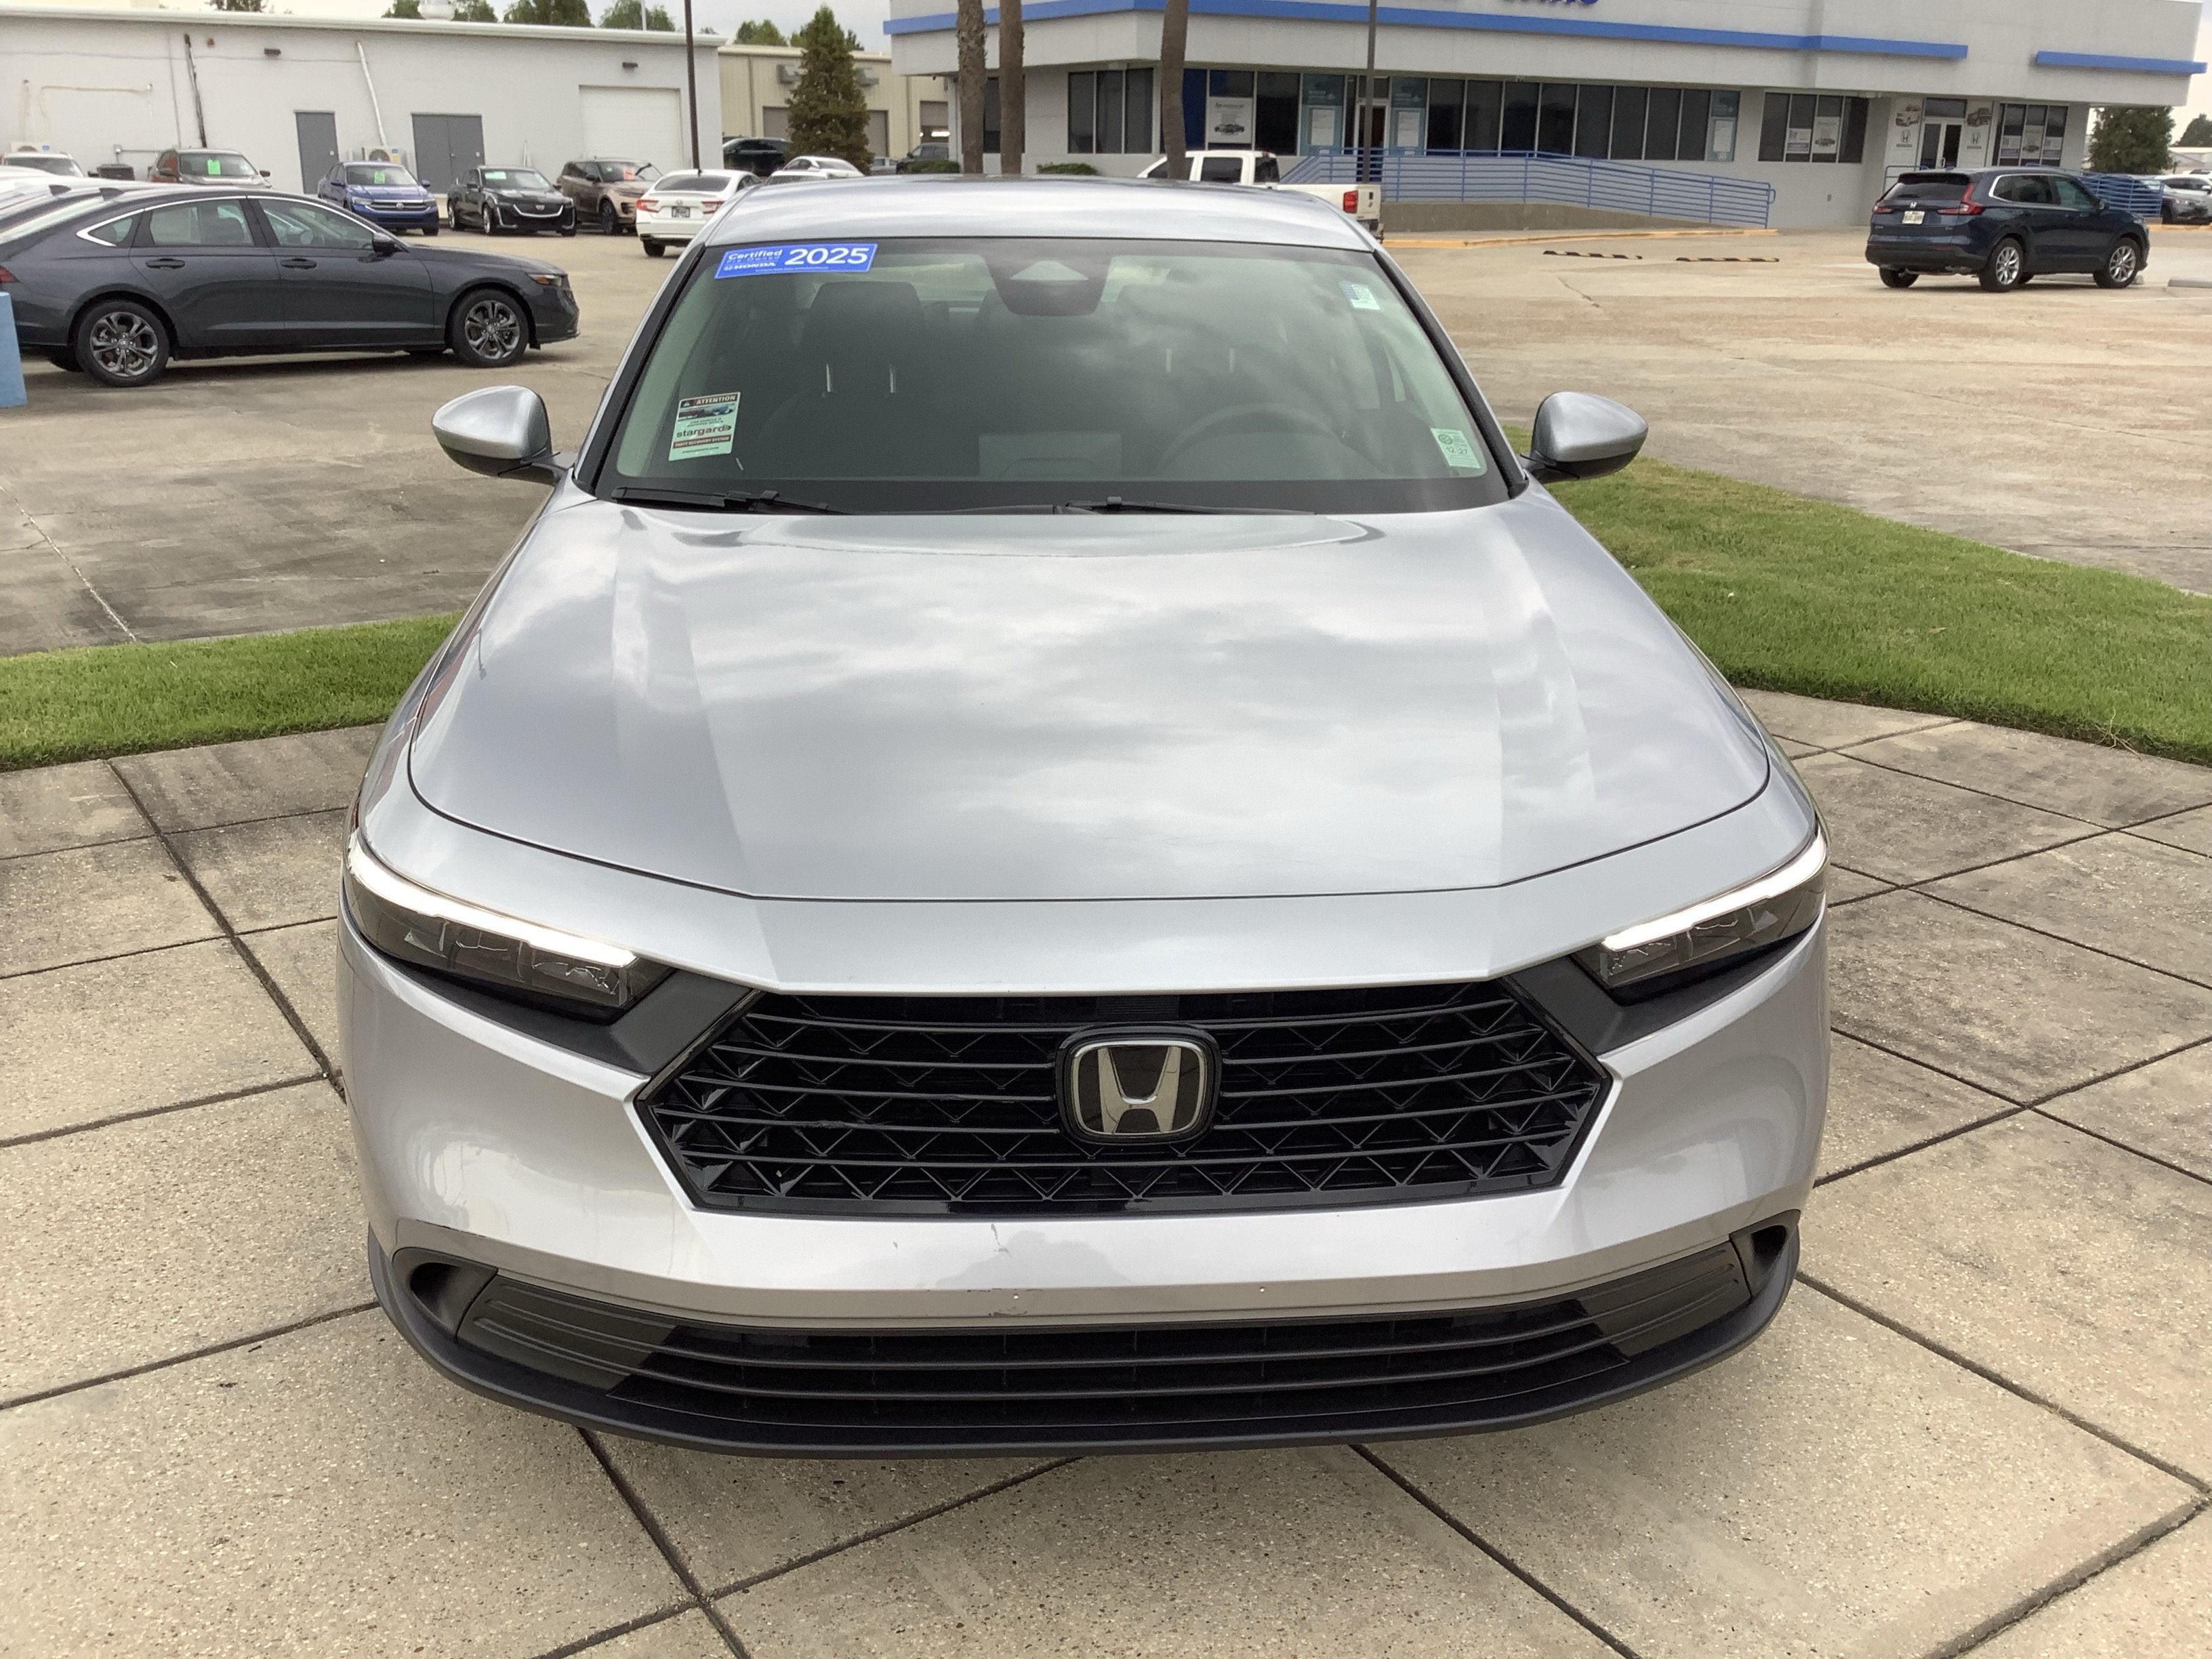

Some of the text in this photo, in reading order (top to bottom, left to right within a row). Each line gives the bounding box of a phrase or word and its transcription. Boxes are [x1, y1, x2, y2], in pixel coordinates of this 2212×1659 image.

[729, 249, 783, 260] Certified
[784, 247, 869, 265] 2025
[696, 396, 736, 405] ATTENTION
